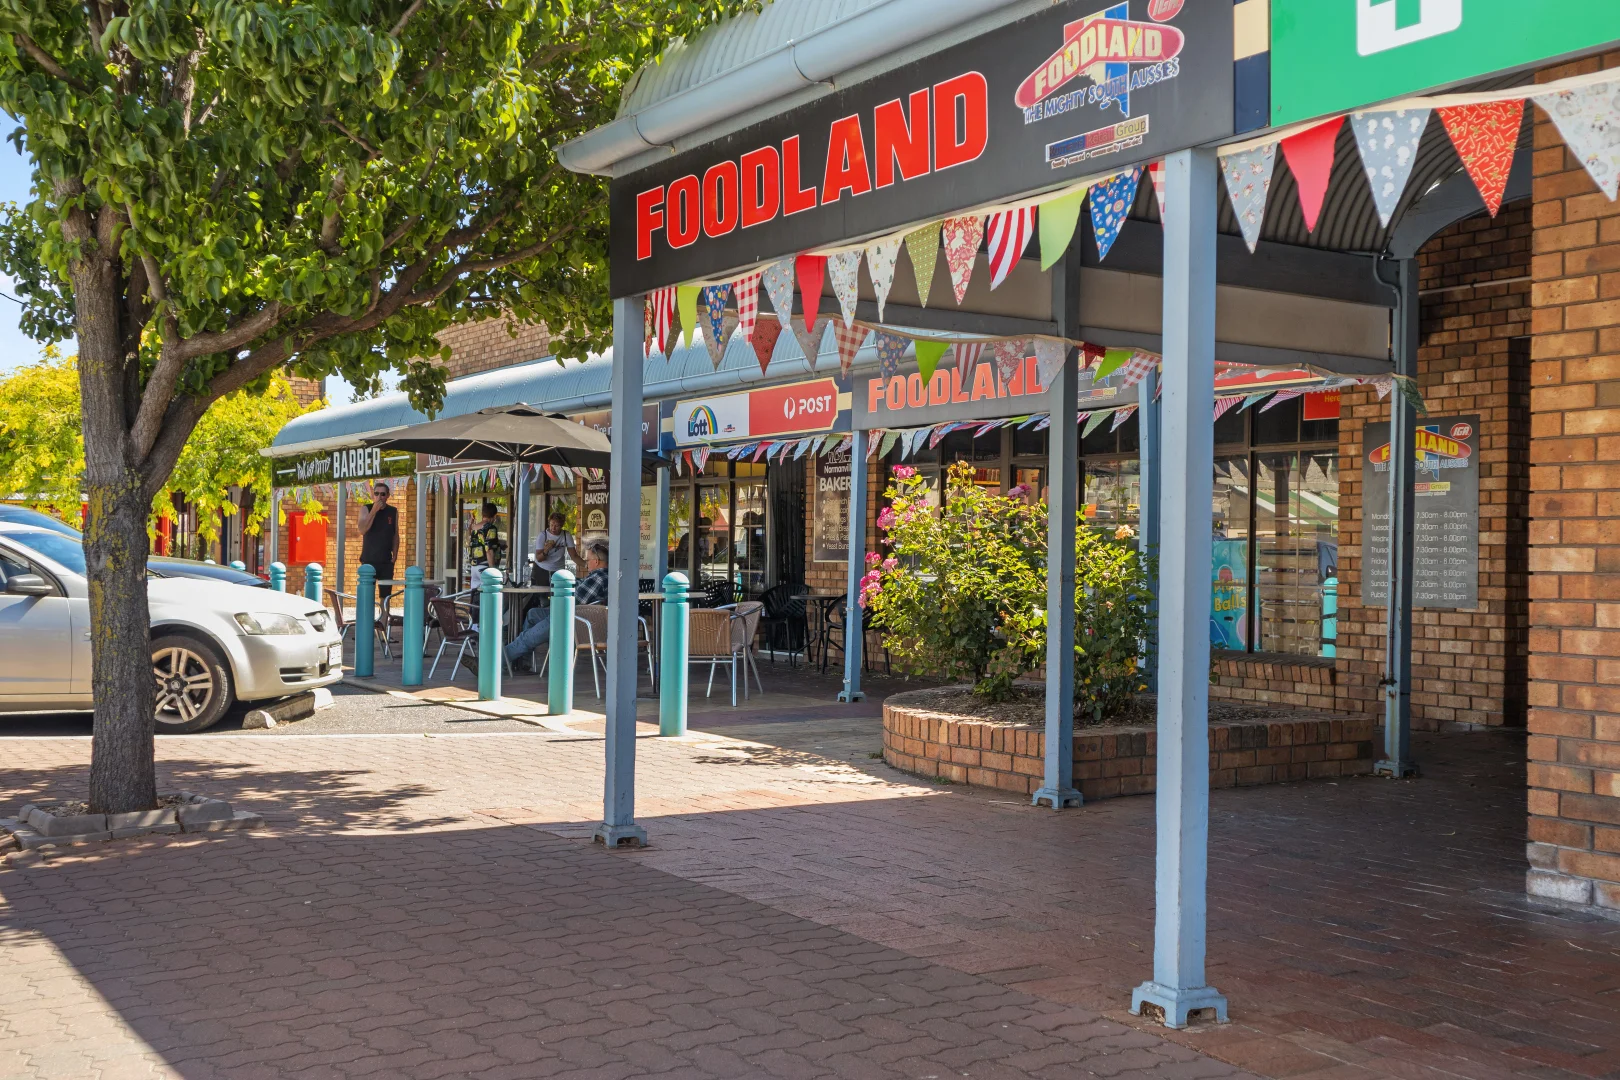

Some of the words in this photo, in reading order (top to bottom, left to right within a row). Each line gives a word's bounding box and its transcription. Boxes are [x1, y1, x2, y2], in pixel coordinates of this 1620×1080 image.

[1034, 23, 1163, 99] FOODLAND
[1023, 102, 1043, 125] THE
[1044, 87, 1087, 118] MIGHTY
[1089, 73, 1129, 105] SOUTH
[1116, 119, 1147, 138] Group
[636, 70, 989, 261] FOODLAND
[799, 395, 832, 415] POST
[1324, 394, 1341, 403] Here
[687, 418, 708, 438] Lott
[1453, 426, 1470, 437] IGA
[333, 447, 381, 479] BARBER
[820, 476, 852, 492] BAKER
[584, 492, 610, 505] BAKERY
[591, 513, 602, 521] OPEN
[640, 532, 651, 541] Food
[1443, 534, 1468, 542] 8.00pm
[1213, 593, 1247, 612] Balls
